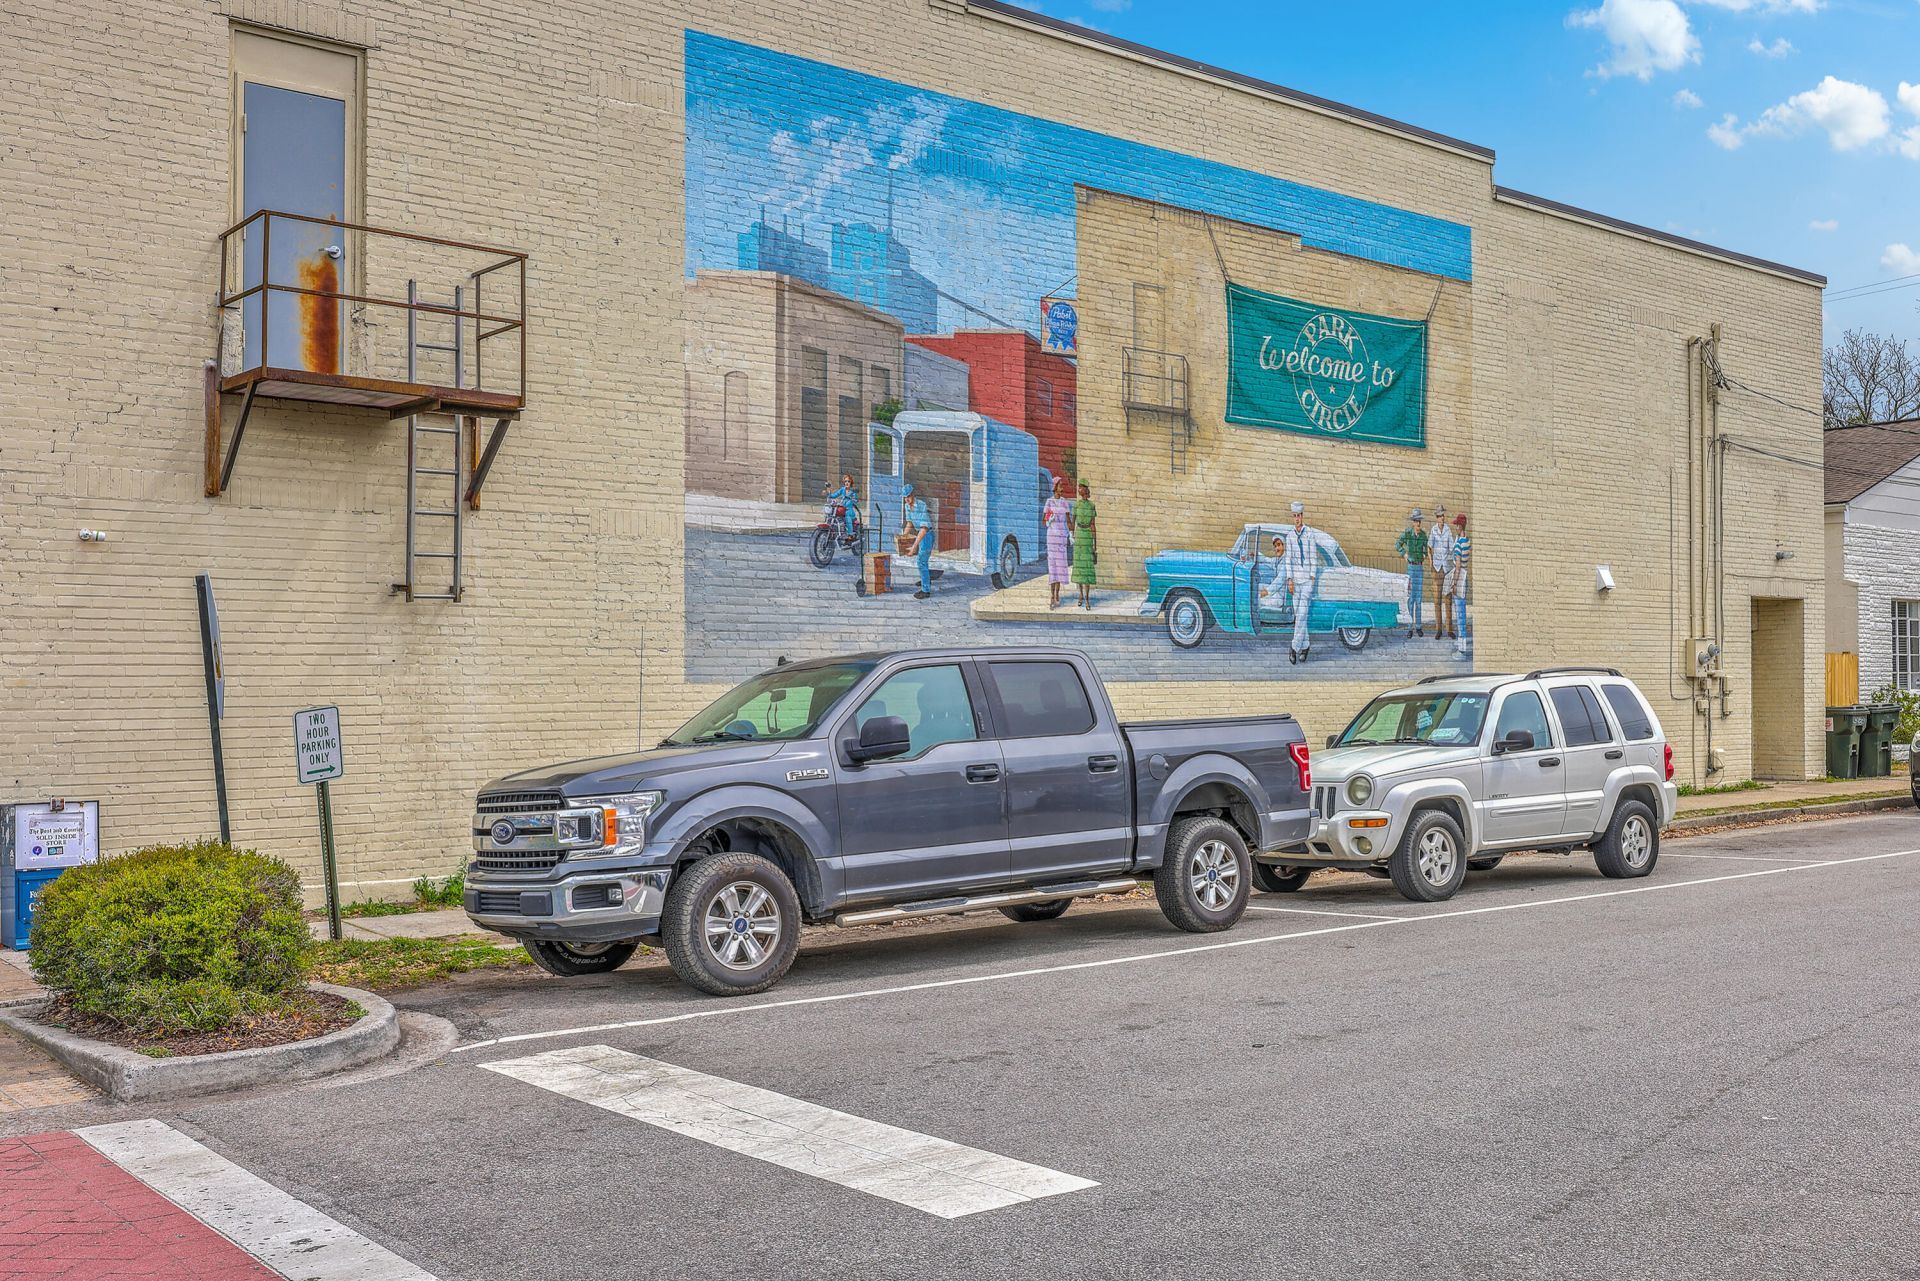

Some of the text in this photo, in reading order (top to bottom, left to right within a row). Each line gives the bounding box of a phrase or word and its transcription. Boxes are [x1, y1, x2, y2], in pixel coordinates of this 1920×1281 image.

[1052, 306, 1072, 319] Pabst
[1302, 315, 1360, 353] PARK
[1259, 335, 1396, 387] Welcome to
[1301, 388, 1363, 431] CIRCLE
[308, 713, 325, 726] TWO
[306, 726, 330, 739] HOUR
[301, 738, 337, 754] PARKING
[309, 752, 330, 765] ONLY
